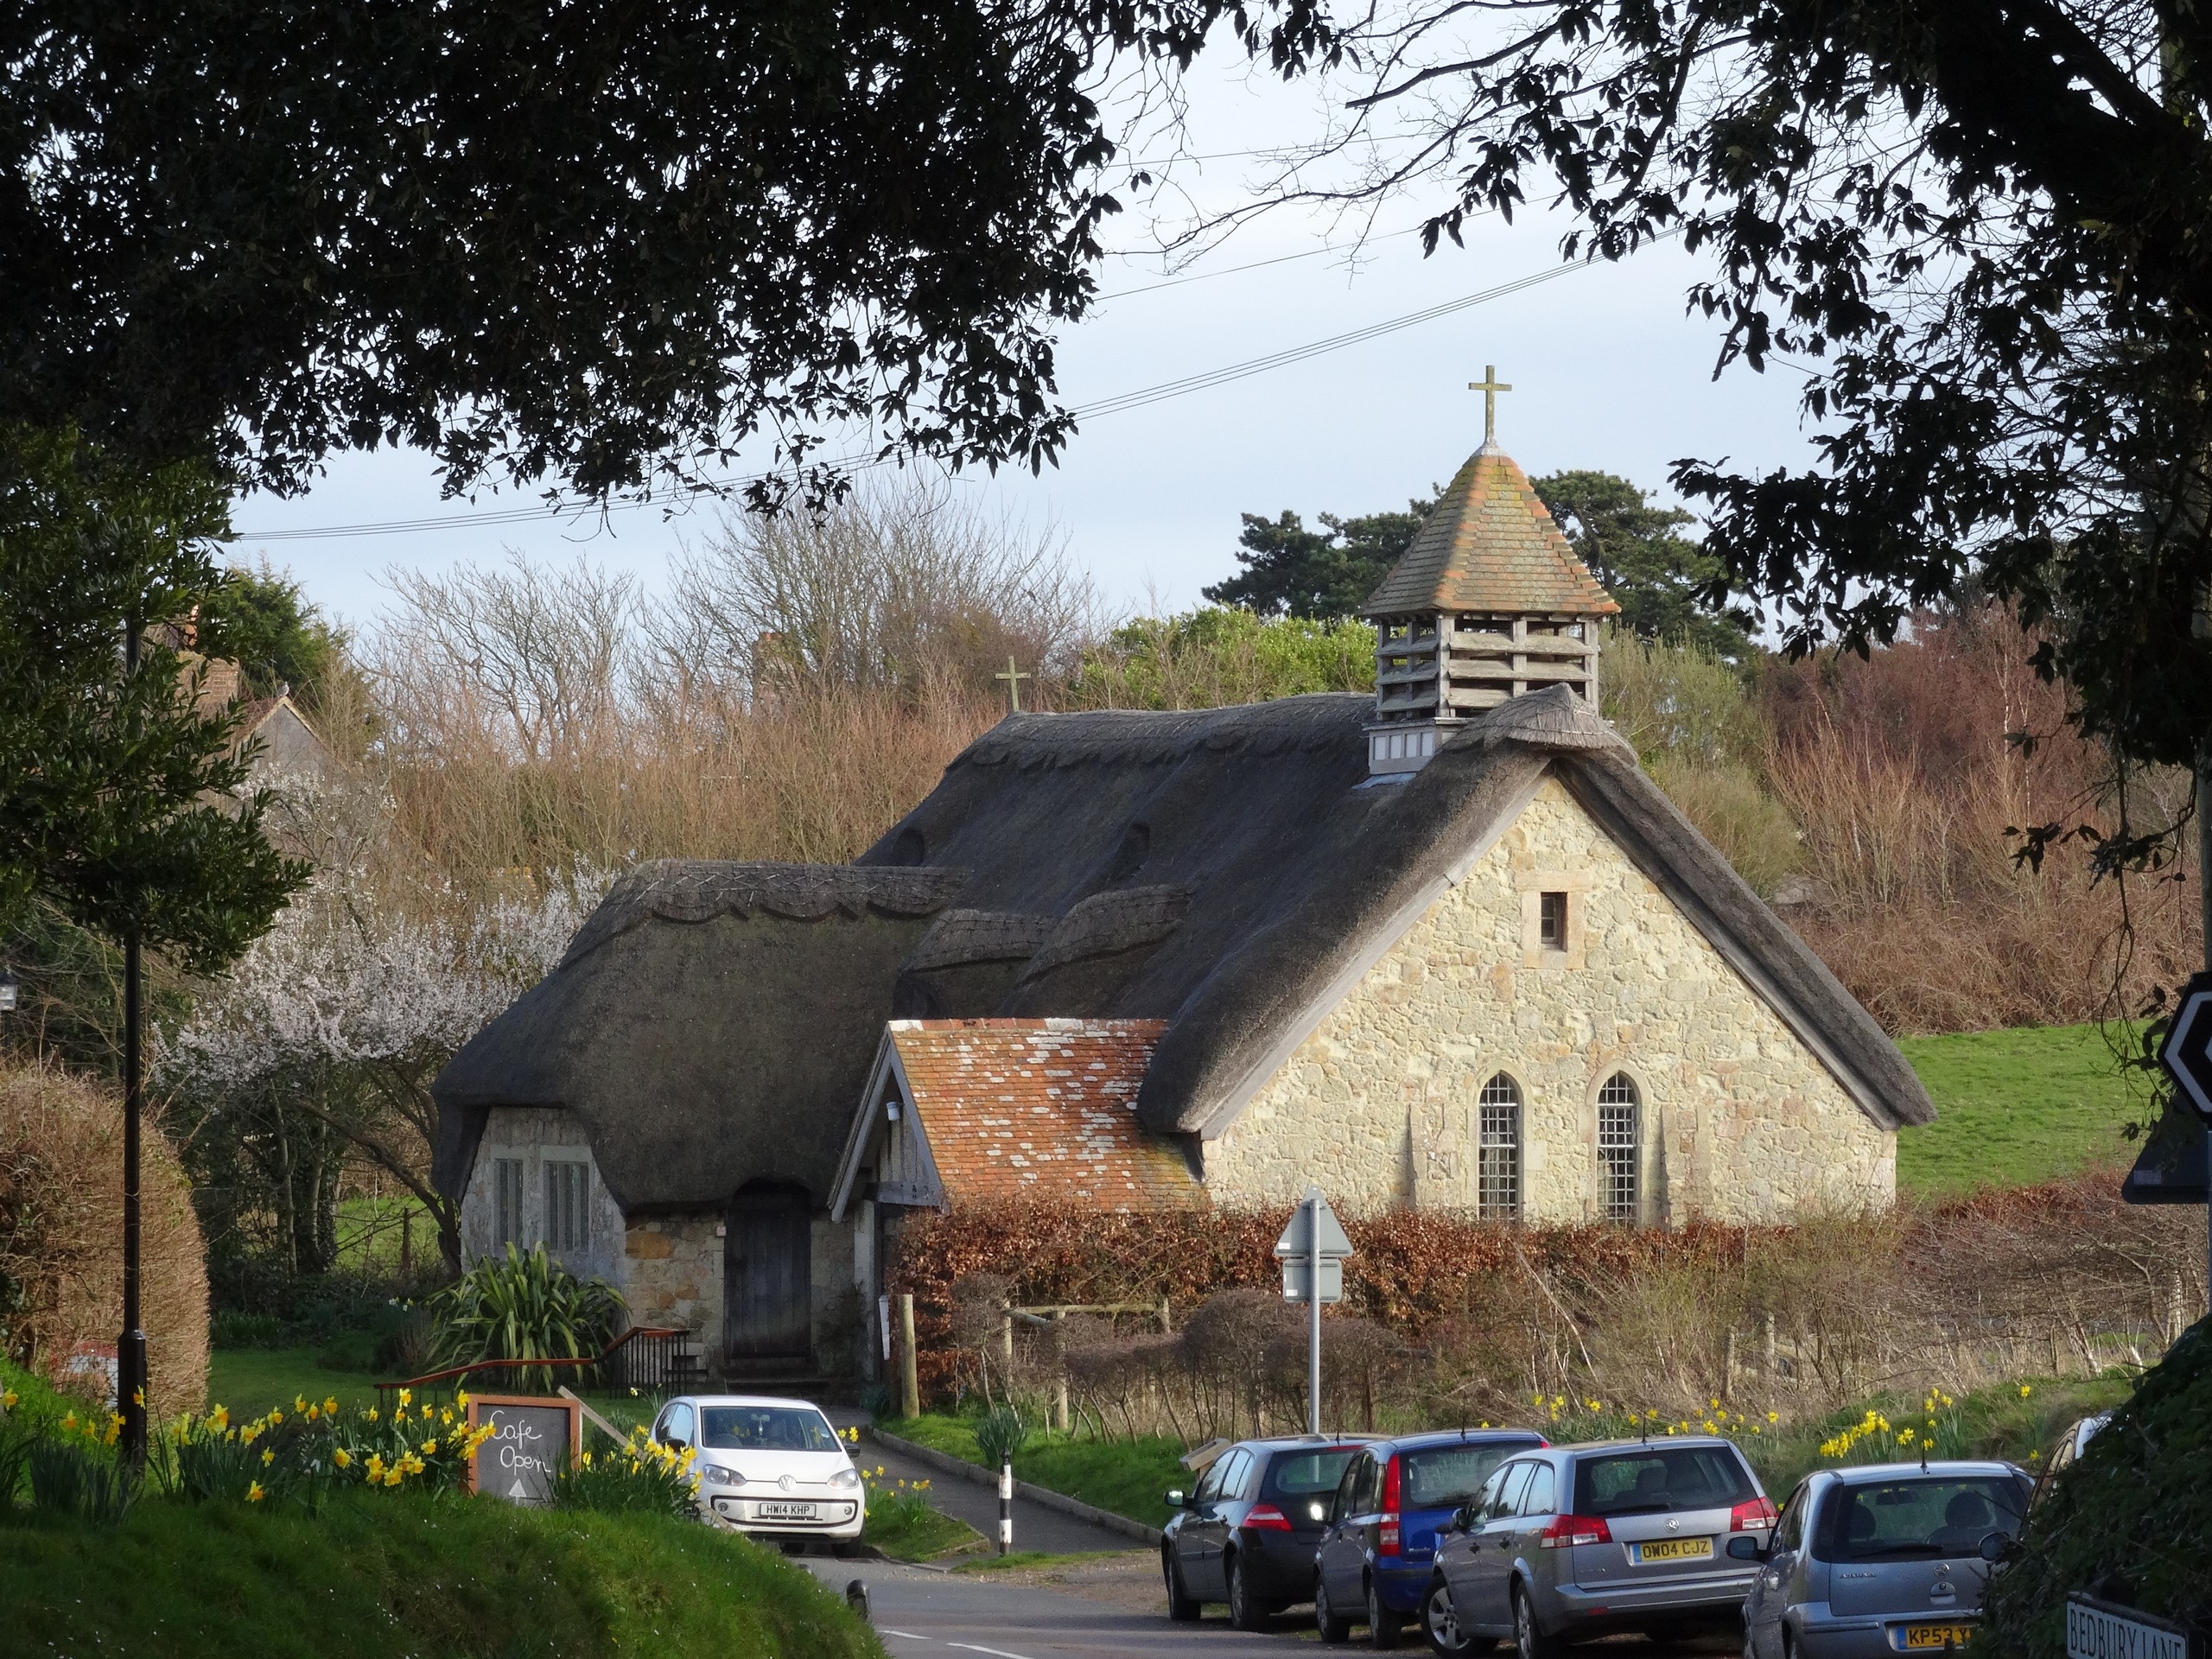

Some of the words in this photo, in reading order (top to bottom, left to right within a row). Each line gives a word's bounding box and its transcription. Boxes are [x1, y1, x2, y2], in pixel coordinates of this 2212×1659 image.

[499, 1446, 551, 1476] Open
[766, 1504, 788, 1514] HW14
[791, 1505, 810, 1516] KHP
[1682, 1541, 1709, 1555] CJZ
[2070, 1608, 2137, 1659] BEDBURY
